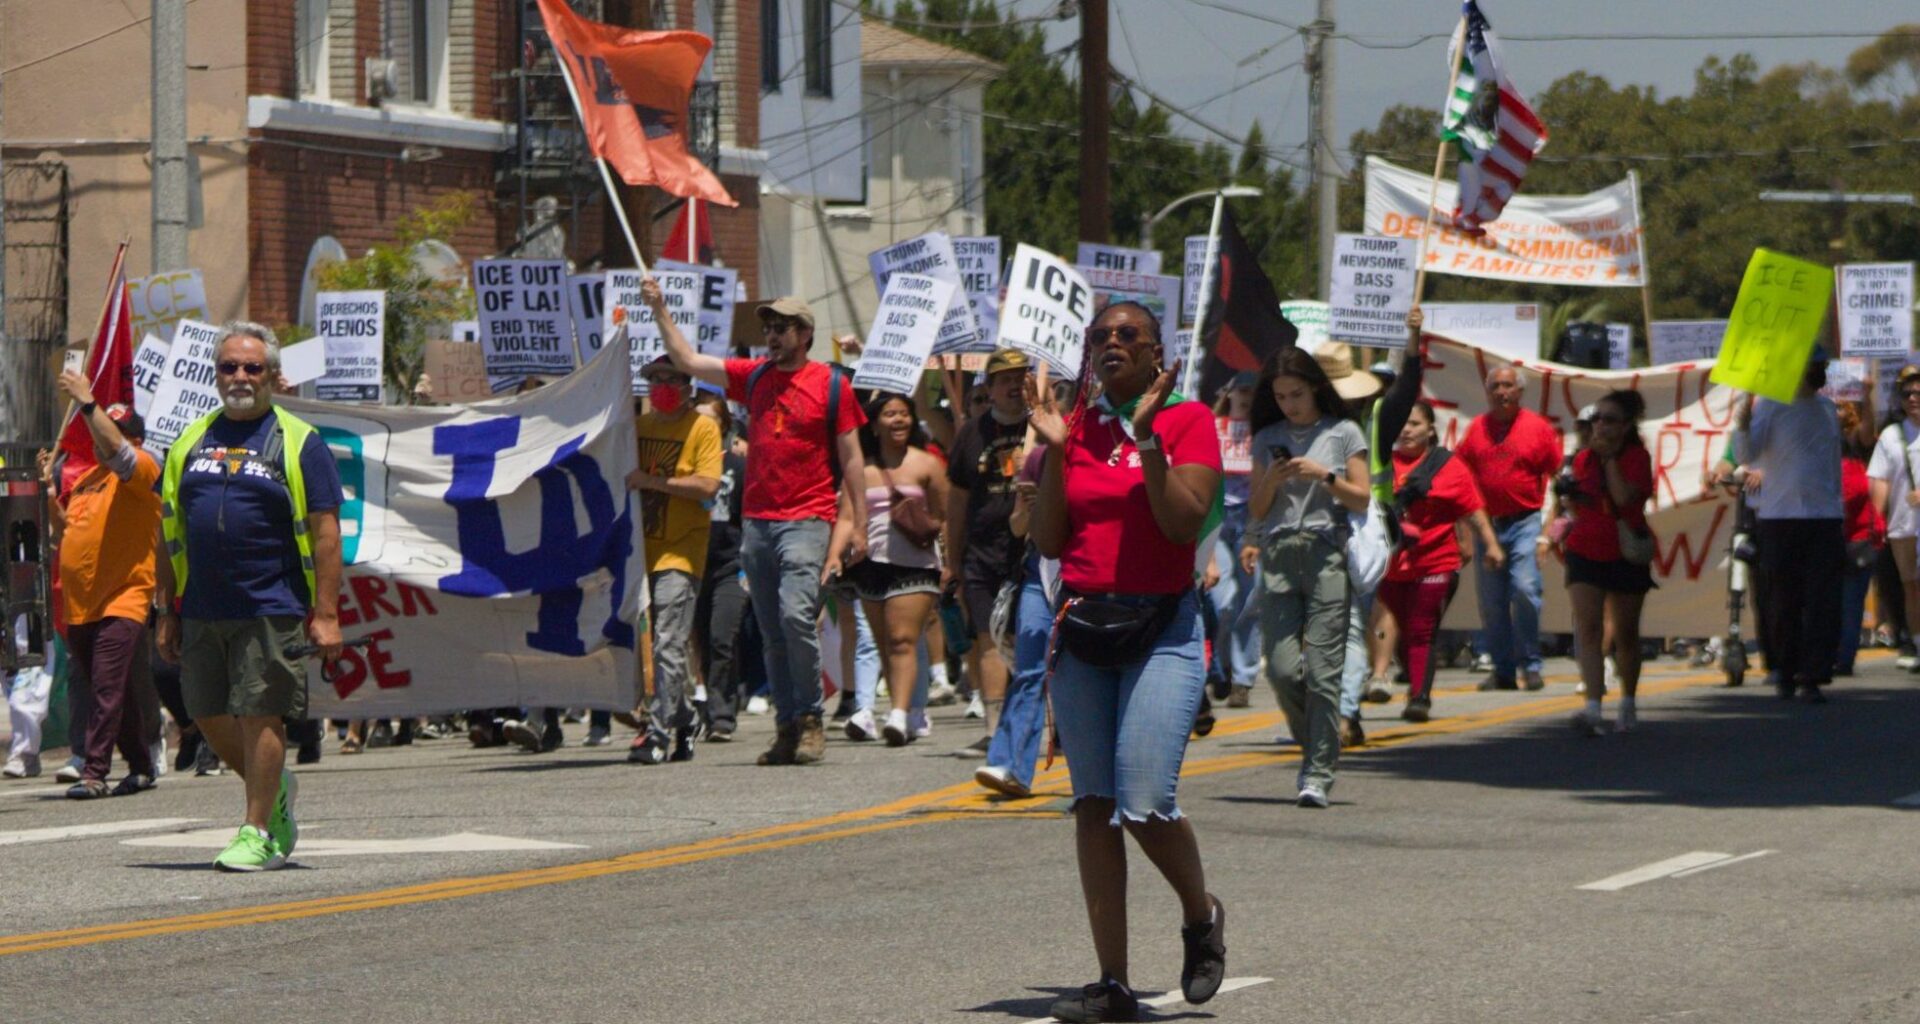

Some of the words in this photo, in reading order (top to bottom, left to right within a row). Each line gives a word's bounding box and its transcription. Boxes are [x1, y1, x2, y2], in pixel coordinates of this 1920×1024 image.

[883, 239, 930, 265] TRUMP,
[1353, 239, 1399, 254] TRUMP,
[1339, 254, 1409, 271] NEWSOME,
[478, 265, 514, 286] ICE
[521, 265, 561, 286] OUT
[1354, 272, 1394, 288] BASS
[1757, 265, 1808, 291] ICE
[1846, 267, 1908, 279] PROTESTING
[665, 276, 693, 290] FOR
[897, 277, 932, 295] TRUMP,
[1025, 257, 1087, 323] ICE
[484, 291, 512, 312] OF
[522, 291, 561, 312] LA!
[885, 294, 937, 317] NEWSOME,
[1354, 294, 1391, 308] STOP
[1849, 292, 1905, 309] CRIME!
[886, 312, 917, 328] BASS
[1743, 298, 1806, 329] OUT
[1861, 315, 1892, 326] DROP
[320, 318, 377, 338] PLENOS
[491, 320, 522, 335] END
[527, 320, 556, 334] THE
[1018, 303, 1056, 330] OUT
[1061, 325, 1080, 346] OF
[1335, 321, 1404, 334] PROTESTERS!
[698, 326, 721, 341] OF
[880, 332, 907, 347] STOP
[491, 337, 561, 352] VIOLENT
[629, 337, 648, 351] OT
[1031, 326, 1067, 360] LA!
[487, 354, 535, 365] CRIMINAL
[539, 354, 571, 365] RAIDS!
[179, 389, 219, 412] DROP
[171, 405, 190, 419] ALL
